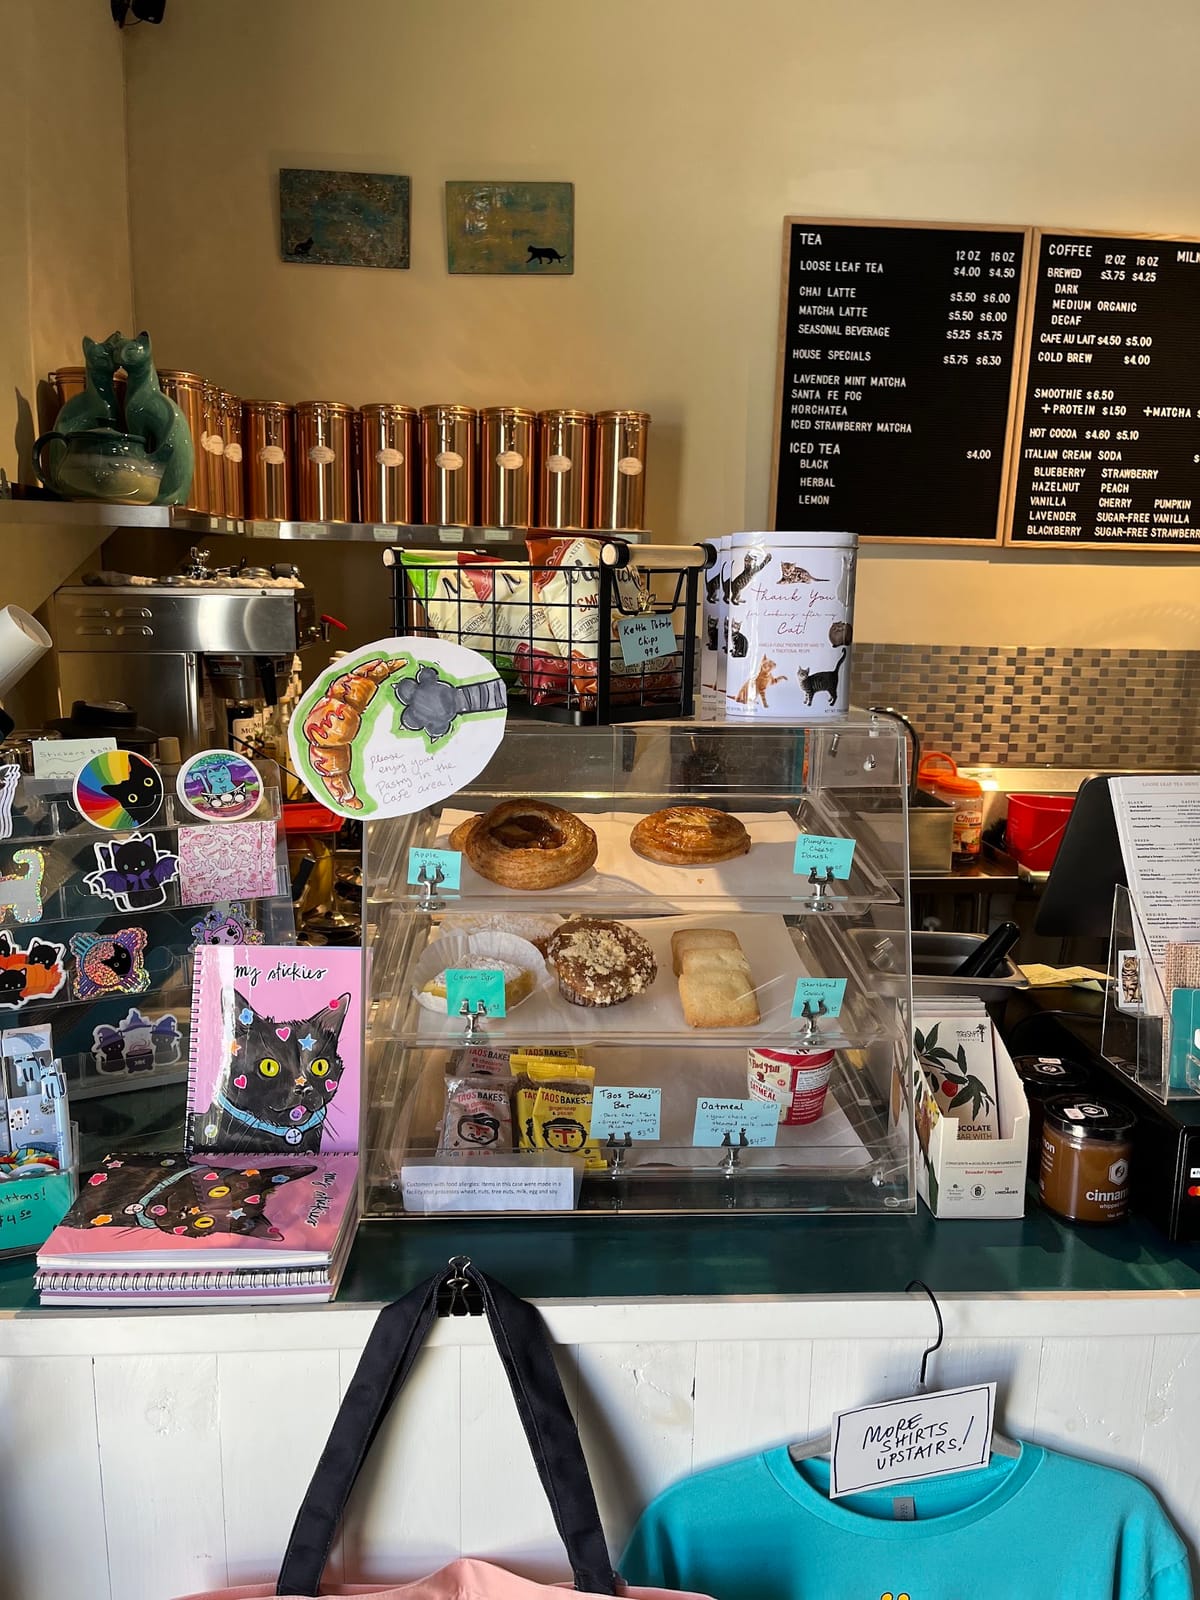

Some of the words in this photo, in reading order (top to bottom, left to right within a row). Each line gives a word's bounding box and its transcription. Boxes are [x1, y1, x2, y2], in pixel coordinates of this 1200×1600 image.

[799, 233, 822, 245] TEA
[1048, 244, 1093, 257] COFFEE
[955, 251, 967, 261] 12
[967, 251, 982, 261] OZ
[989, 252, 1002, 262] 16
[1002, 252, 1016, 262] OZ
[1104, 255, 1114, 264] 12
[1114, 255, 1127, 265] OZ
[1136, 256, 1146, 265] 16
[1146, 257, 1160, 266] OZ
[800, 261, 832, 271] LOOSE
[834, 262, 861, 272] LEAF
[864, 263, 884, 273] TEA
[1047, 268, 1082, 278] BREWED
[799, 286, 822, 296] CHAI
[827, 288, 857, 297] LATTE
[1054, 284, 1079, 294] DARK
[798, 306, 835, 315] MATCHA
[838, 307, 868, 317] LATTE
[1052, 300, 1092, 310] MEDIUM
[1097, 301, 1137, 312] ORGANIC
[1051, 315, 1083, 325] DECAF
[797, 324, 842, 335] SEASONAL
[844, 326, 891, 336] BEVERAGE
[1040, 333, 1062, 343] CAFE
[1062, 334, 1076, 344] AU
[1076, 335, 1097, 344] LAIT
[792, 349, 822, 359] HOUSE
[827, 350, 872, 361] SPECIALS
[1037, 352, 1064, 362] COLD
[1066, 353, 1093, 363] BREW
[793, 374, 841, 384] LAVENDER
[844, 376, 867, 385] MINT
[870, 377, 907, 387] MATCHA
[791, 389, 821, 399] SANTA
[827, 391, 839, 400] FE
[844, 391, 863, 400] FOG
[1033, 388, 1083, 399] SMOOTHIE
[790, 405, 848, 415] HORCHATEA
[790, 420, 812, 429] ICED
[813, 420, 873, 431] STRAWBERRY
[876, 423, 912, 432] MATCHA
[1029, 428, 1047, 437] HOT
[1049, 428, 1078, 438] COCOA
[789, 443, 815, 453] ICED
[818, 443, 841, 454] TEA
[1024, 449, 1059, 459] ITALIAN
[1061, 450, 1092, 460] CREAM
[1097, 451, 1122, 460] SODA
[799, 459, 829, 469] BLACK
[1033, 467, 1086, 477] BLUEBERRY
[1100, 468, 1159, 479] STRAWBERRY
[799, 477, 836, 487] HERBAL
[1031, 482, 1081, 492] HAZELNUT
[1100, 483, 1130, 493] PEACH
[798, 495, 830, 504] LEMON
[1030, 496, 1067, 506] VANILLA
[1098, 498, 1133, 508] CHERRY
[1153, 499, 1192, 509] PUMPKIN
[1029, 511, 1077, 521] LAVENDER
[1095, 512, 1151, 523] SUGAR-FREE
[1152, 514, 1190, 523] VANILLA
[1026, 525, 1082, 536] BLACKBERRY
[1093, 527, 1149, 537] SUGAR-FREE
[234, 965, 261, 987] my
[267, 961, 327, 981] stickies
[541, 1091, 560, 1104] TAOS
[560, 1096, 586, 1105] BAKES
[600, 1089, 622, 1099] Taos
[701, 1101, 744, 1111] Oatmeal
[0, 1186, 46, 1204] ttons!
[862, 1413, 923, 1450] MORE
[880, 1421, 948, 1453] SHIRTS
